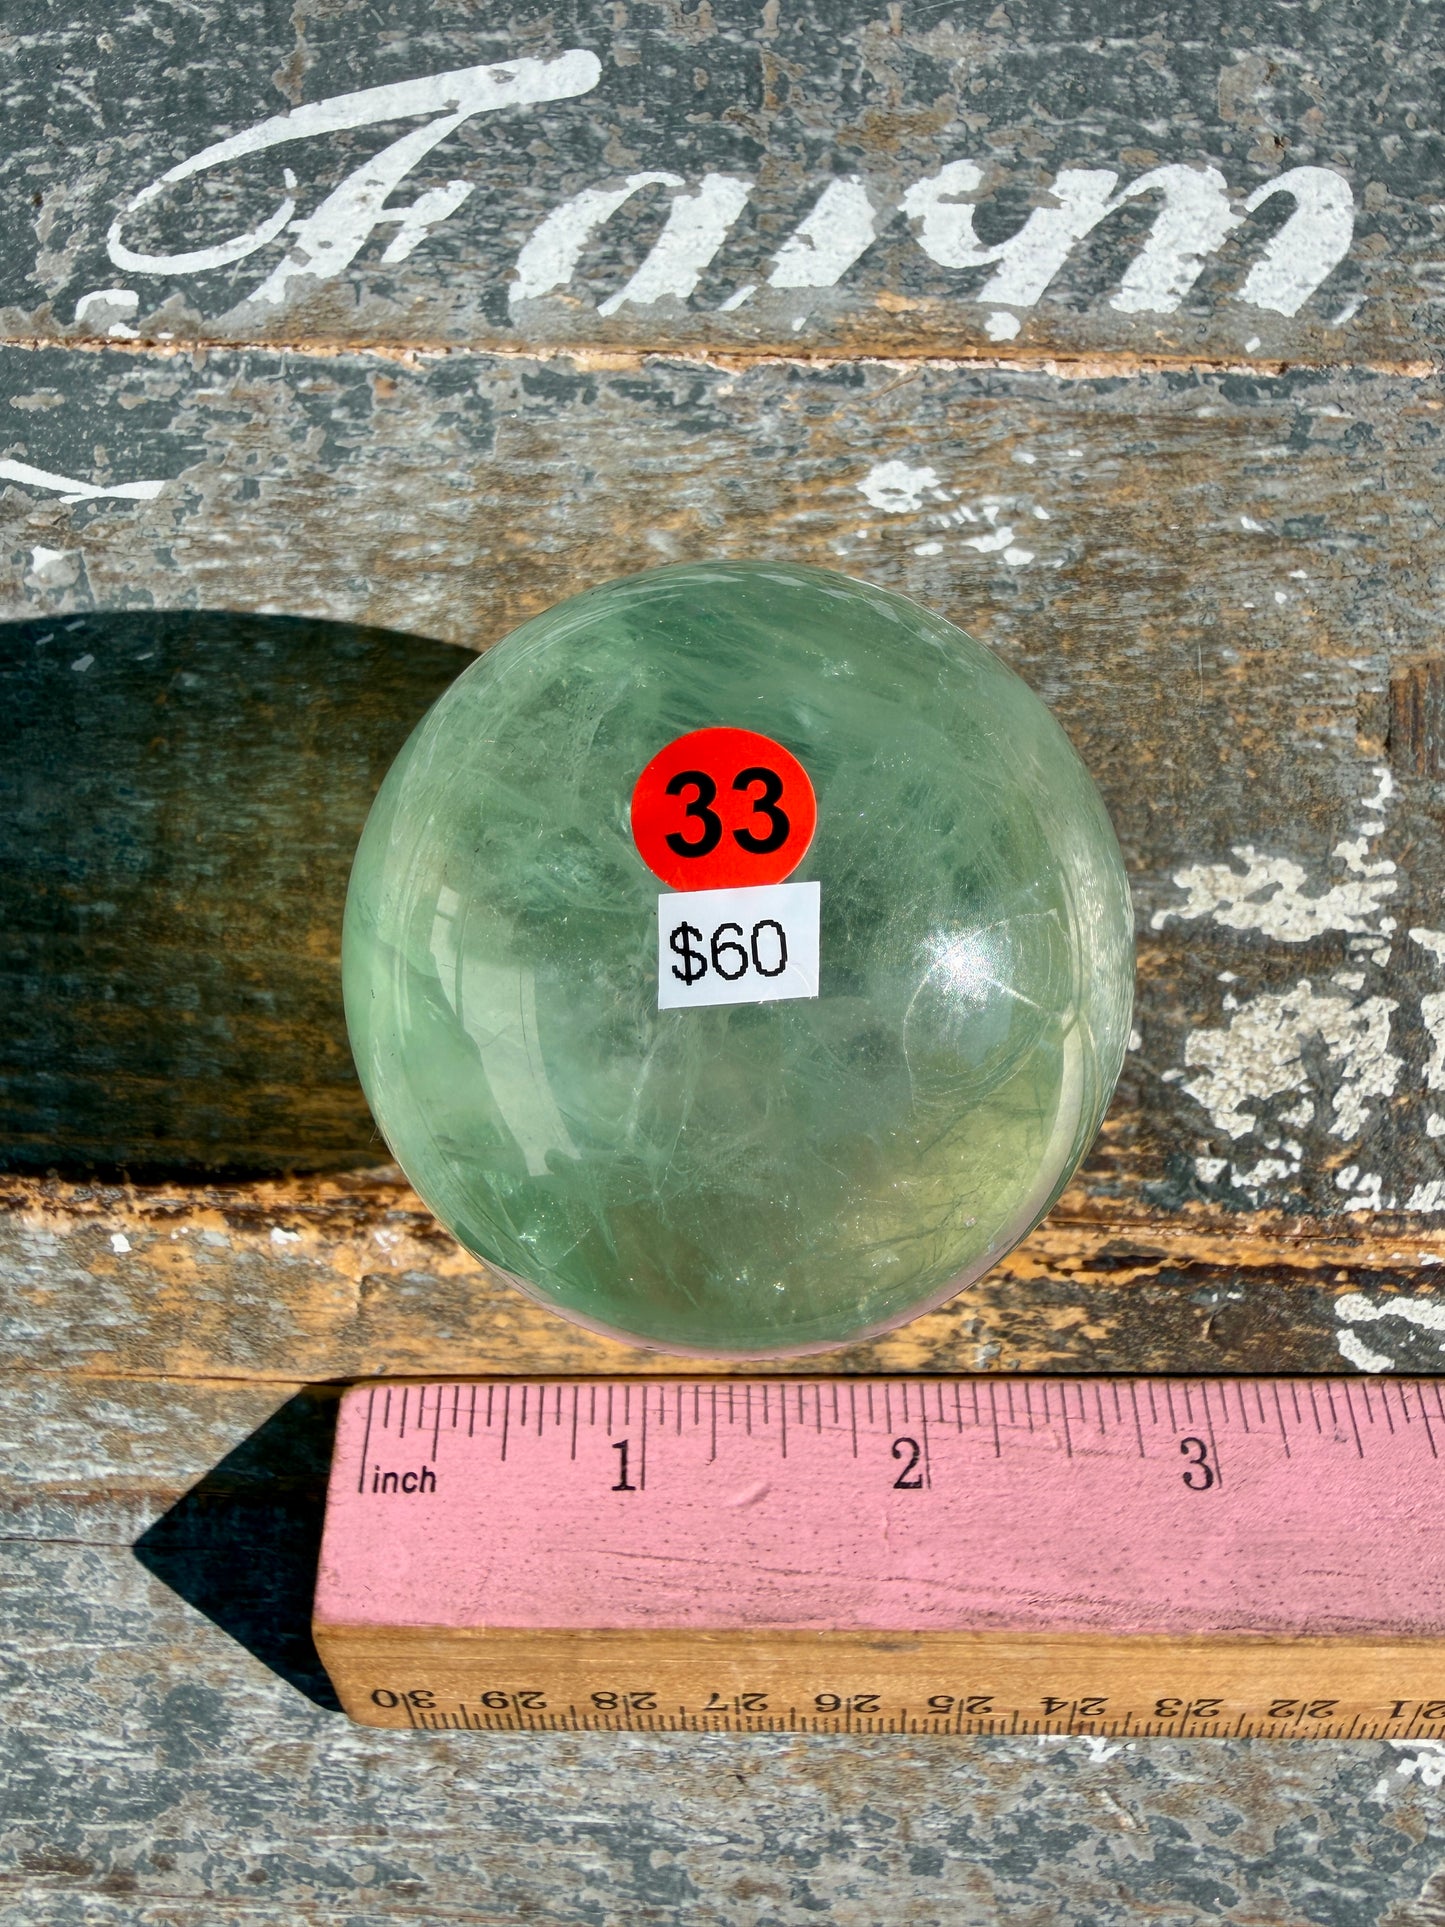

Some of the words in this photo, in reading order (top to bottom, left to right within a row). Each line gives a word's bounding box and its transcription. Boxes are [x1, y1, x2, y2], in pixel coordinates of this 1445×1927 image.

[664, 766, 791, 859] 33
[669, 919, 788, 987] $60
[371, 1464, 438, 1495] inch
[611, 1439, 637, 1492] 1
[891, 1436, 924, 1490] 2
[1180, 1436, 1215, 1491] 3
[370, 1688, 437, 1709] 30
[480, 1690, 548, 1710] 29
[590, 1690, 658, 1711] 28
[703, 1691, 769, 1712] 27
[813, 1692, 882, 1713] 26
[927, 1694, 996, 1715] 25
[1039, 1696, 1110, 1717] 24
[1153, 1697, 1225, 1718] 23
[1267, 1698, 1341, 1719] 22
